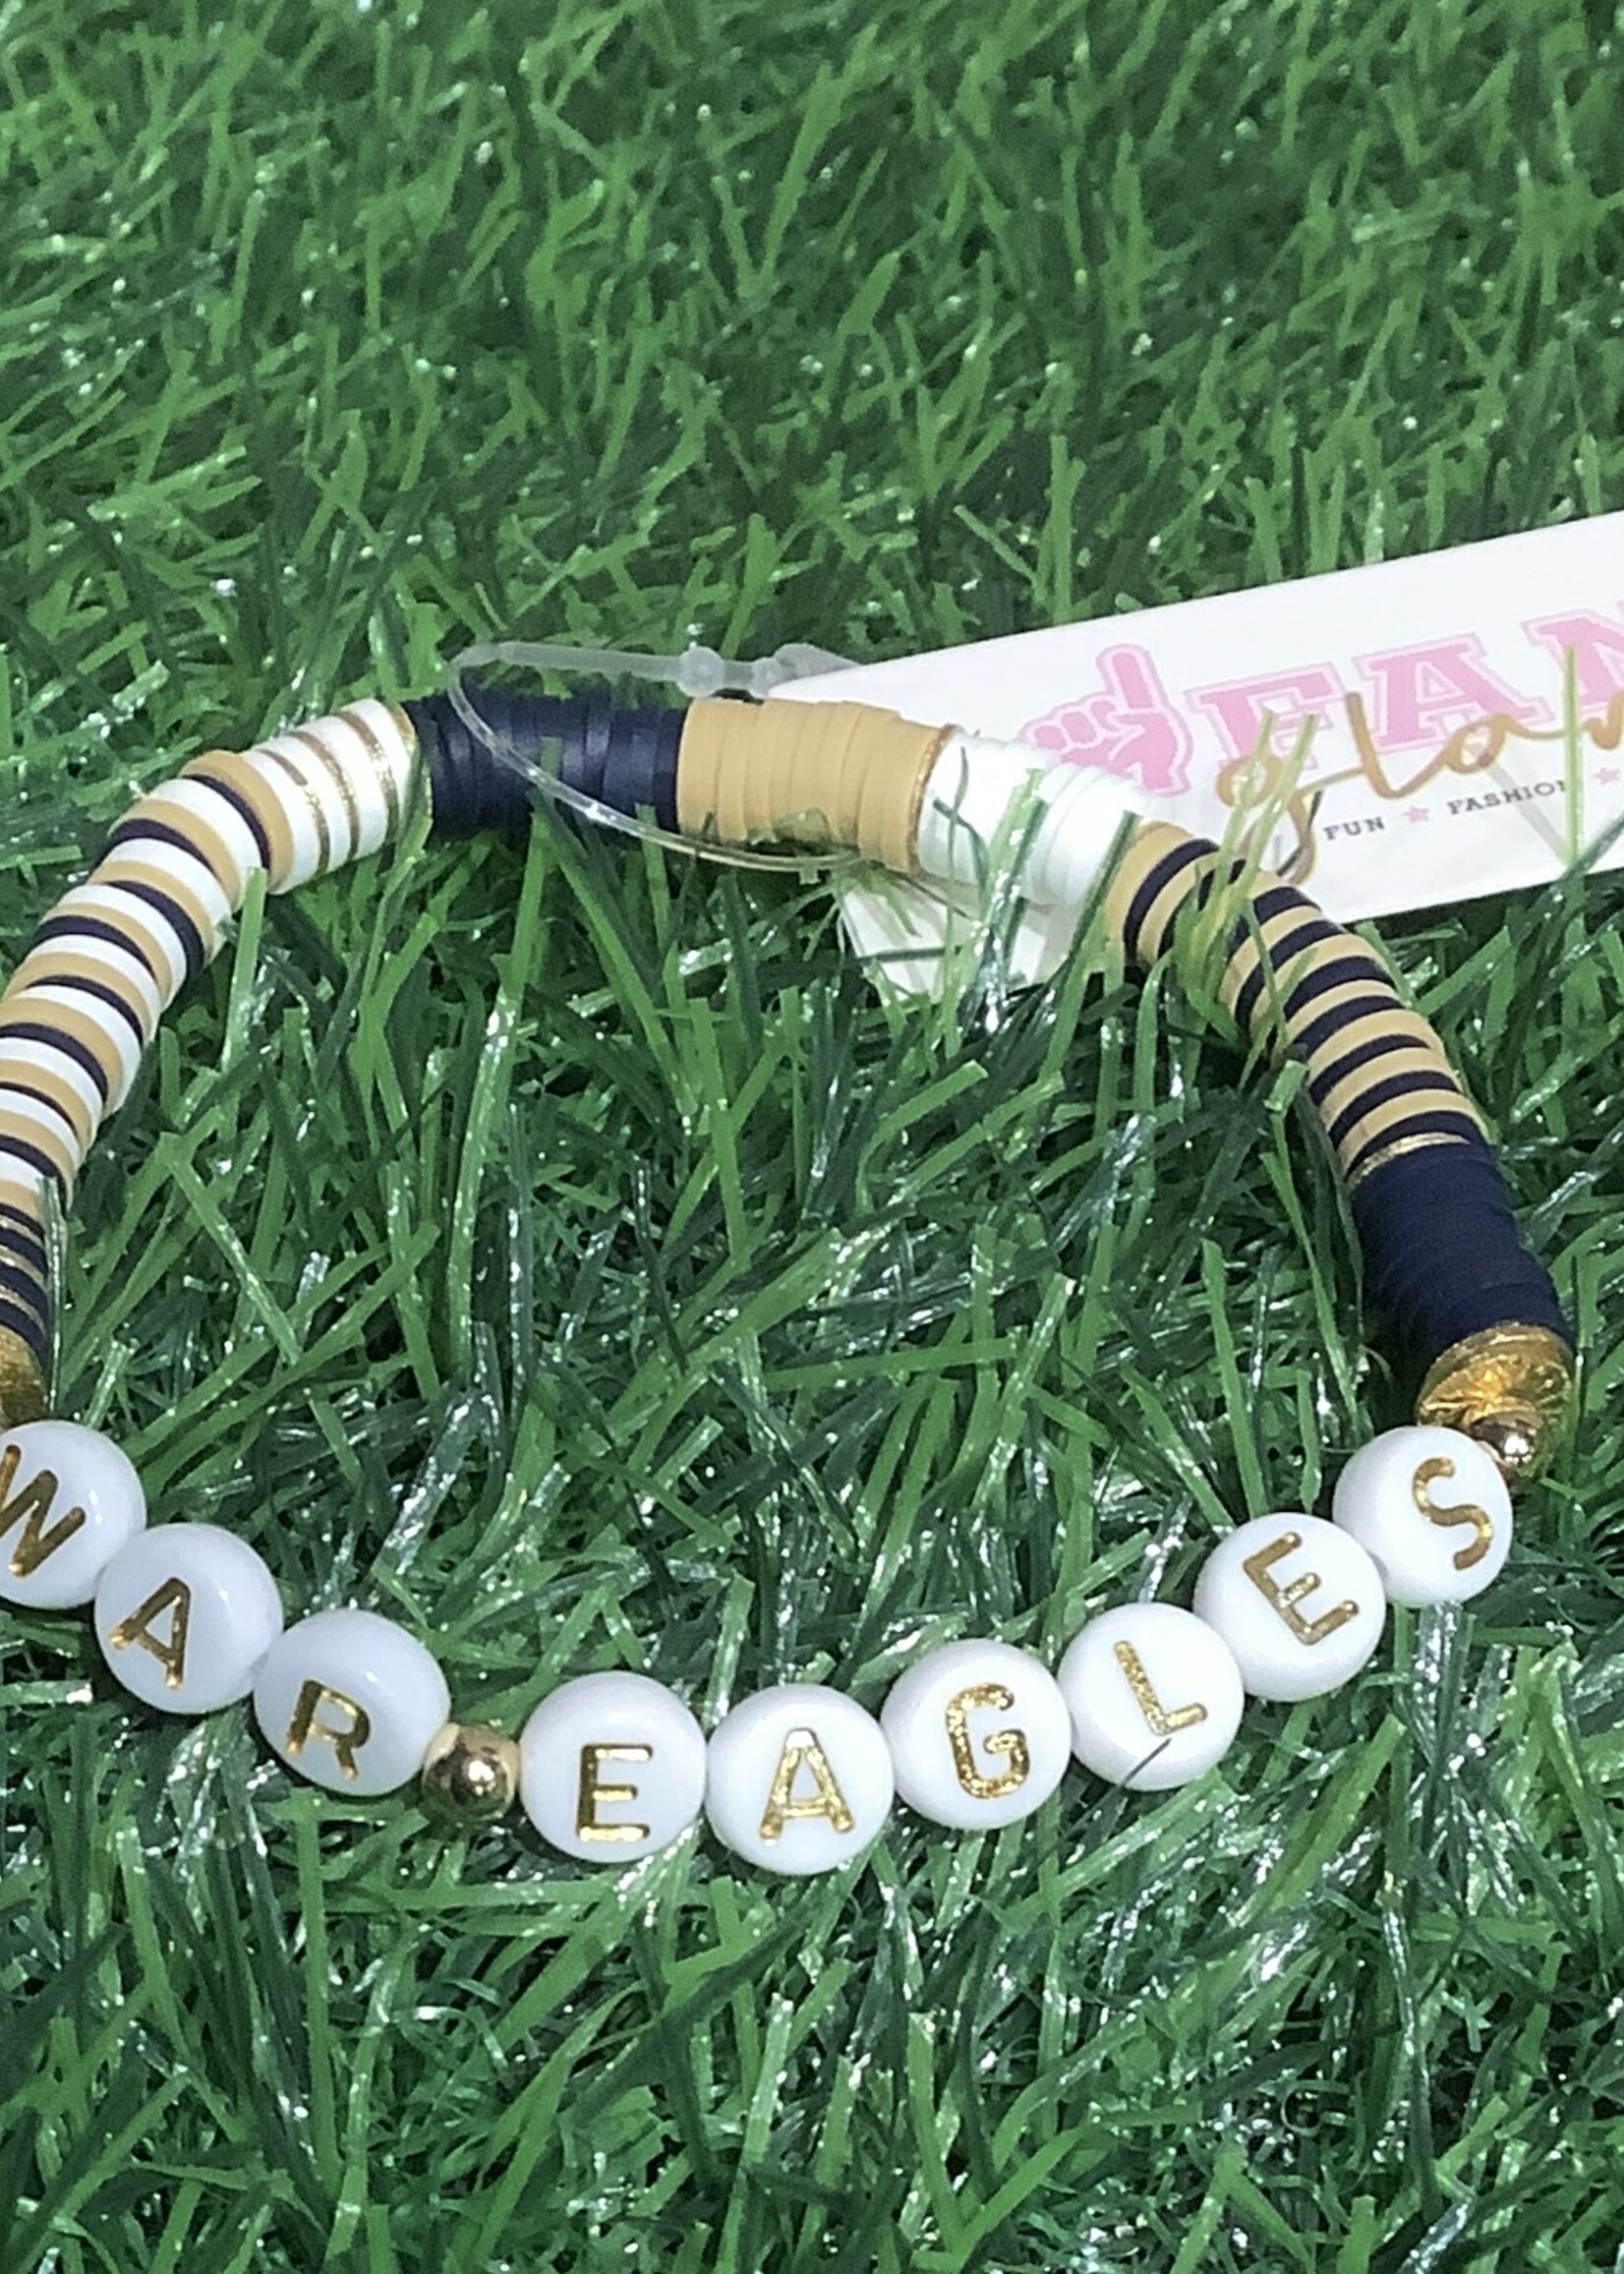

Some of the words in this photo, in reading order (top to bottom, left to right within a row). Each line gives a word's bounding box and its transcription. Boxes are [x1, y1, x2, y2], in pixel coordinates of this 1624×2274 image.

[1215, 691, 1624, 888] gla
[1323, 816, 1385, 841] FUN
[0, 1444, 372, 1780] WAR
[575, 1456, 1495, 1844] EAGLES
